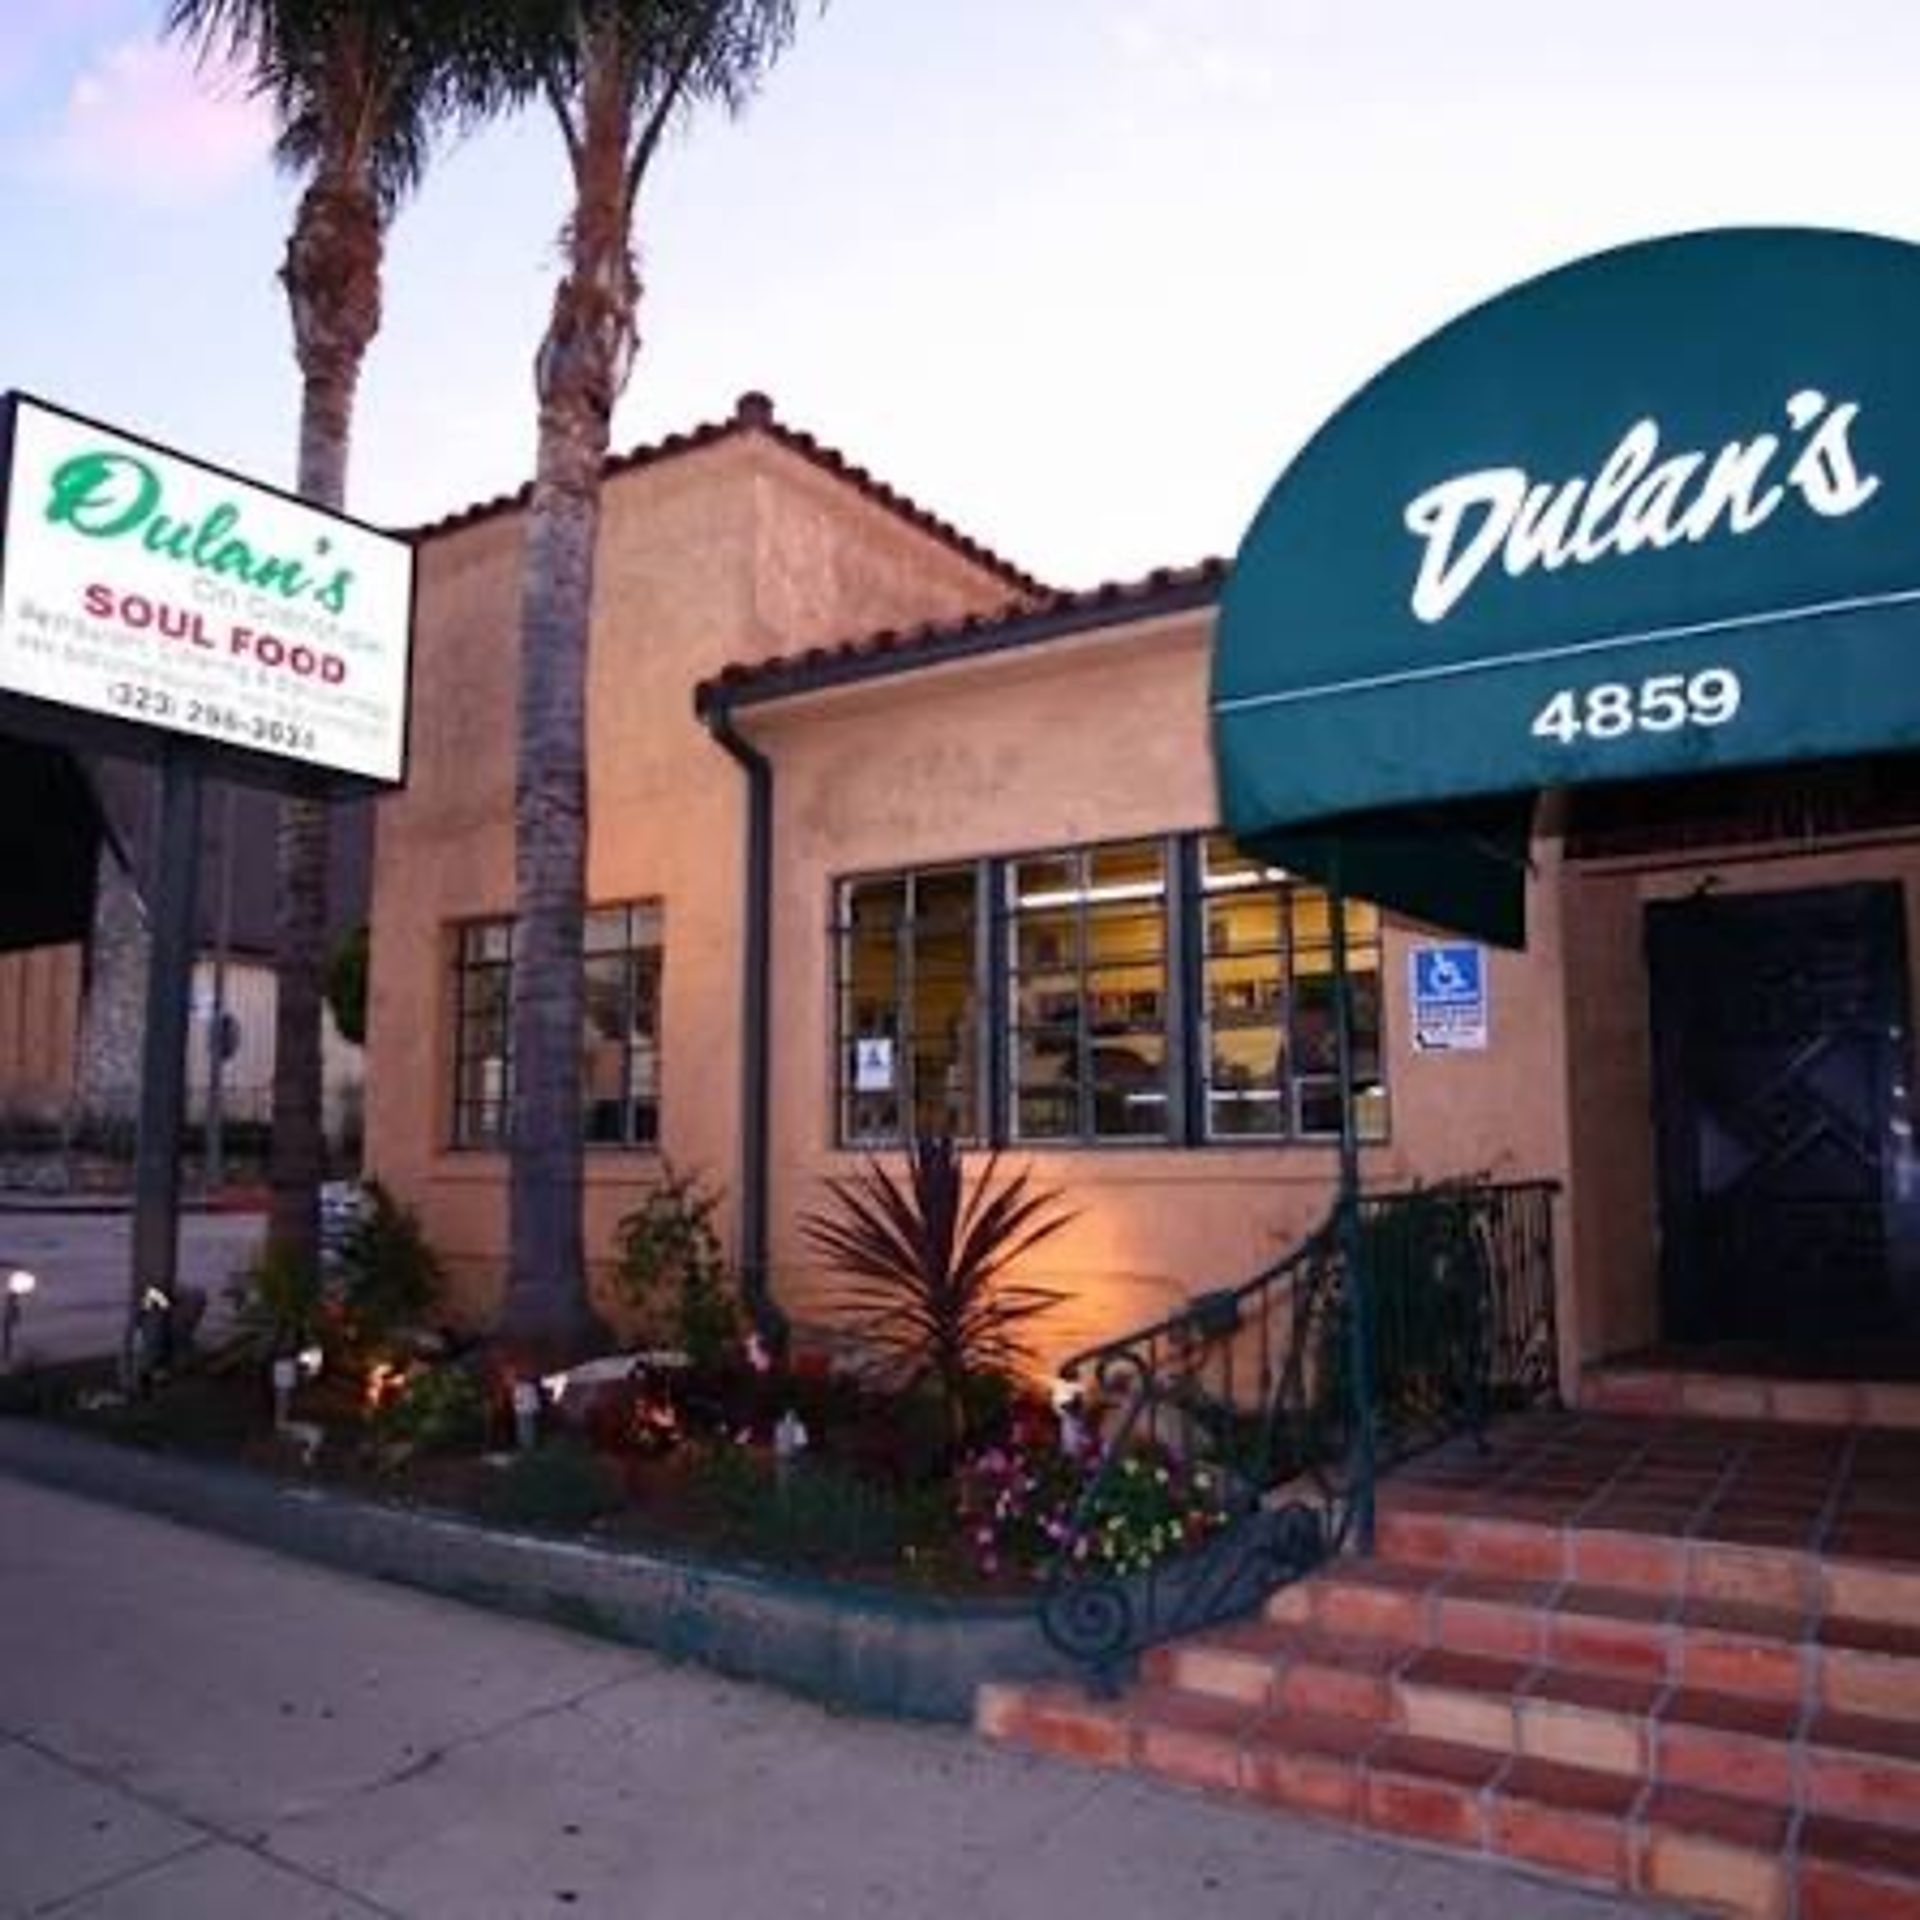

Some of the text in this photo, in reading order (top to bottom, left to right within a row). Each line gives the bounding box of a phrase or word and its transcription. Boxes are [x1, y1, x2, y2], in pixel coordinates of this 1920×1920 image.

[45, 451, 352, 614] Dulan's
[1405, 391, 1879, 623] Dulan's
[84, 584, 215, 649] SOUL
[230, 626, 346, 685] FOOD
[1531, 669, 1741, 744] 4859
